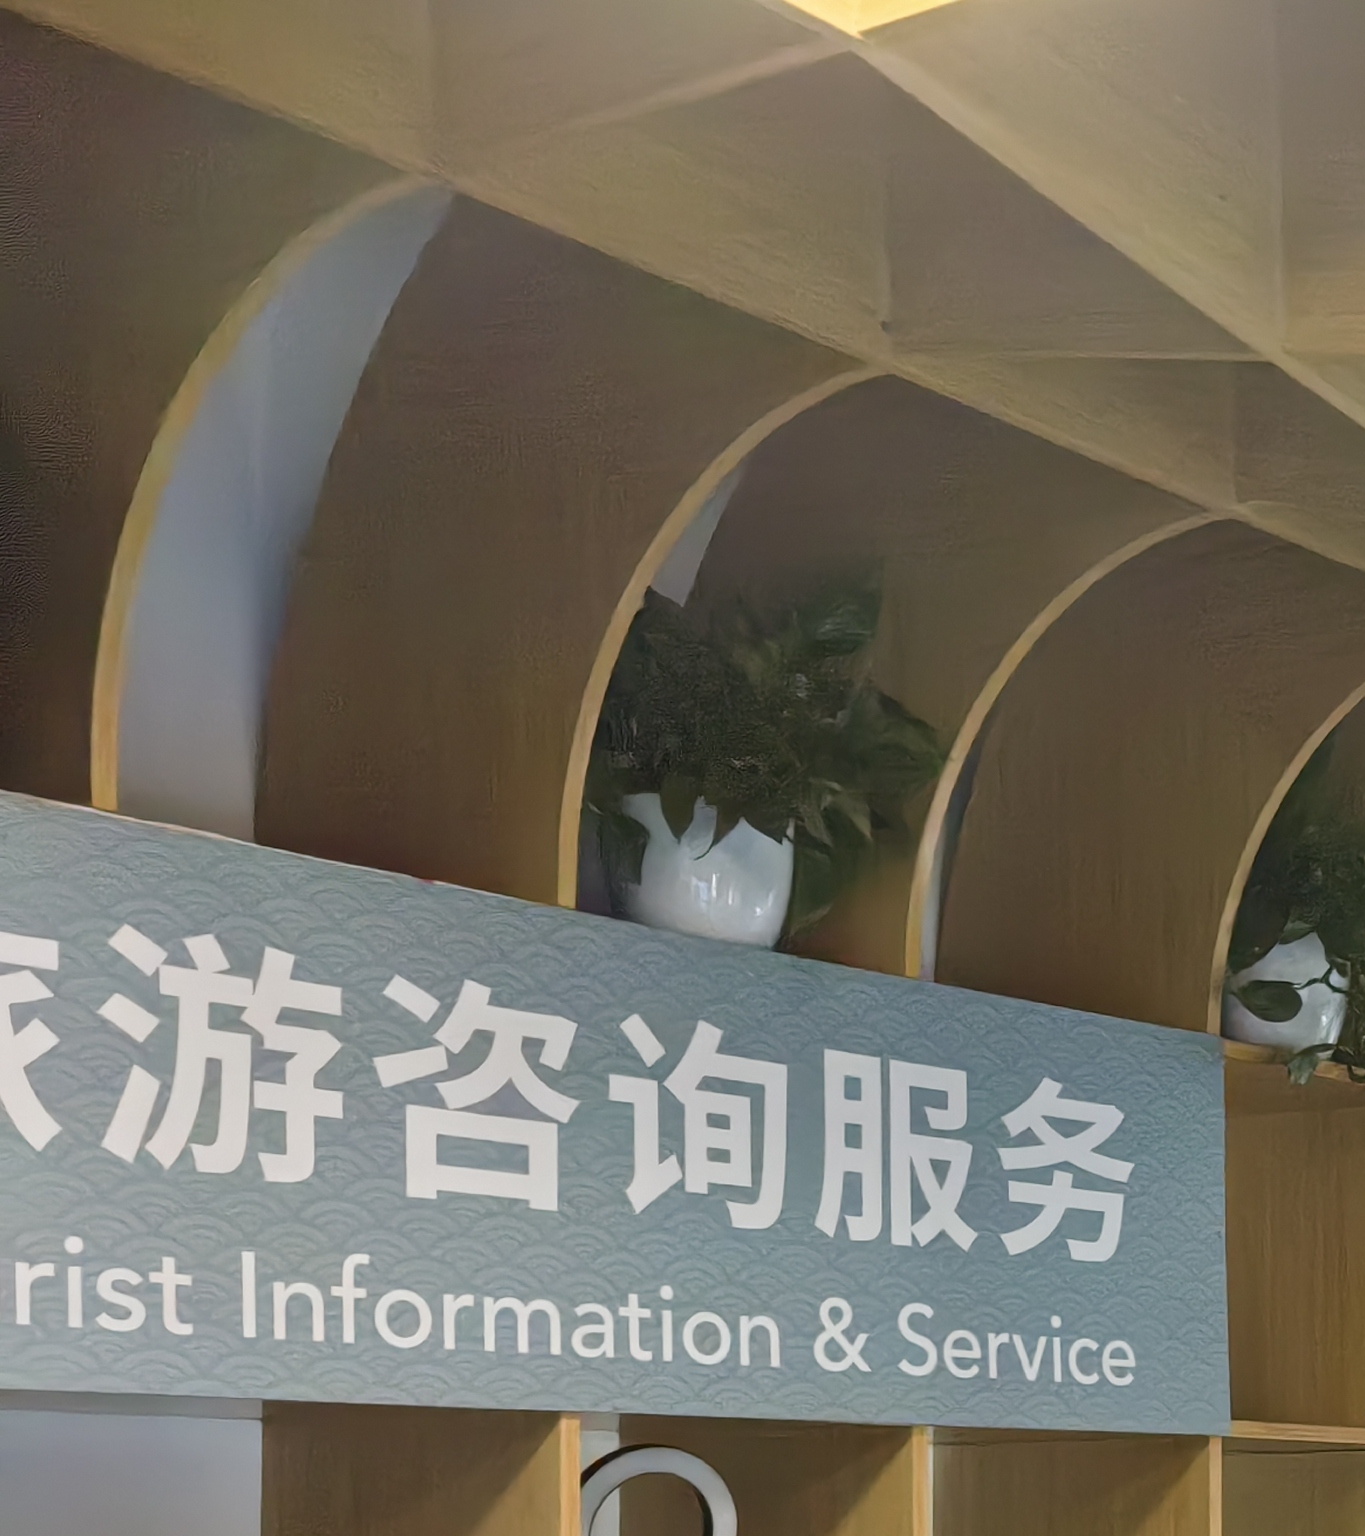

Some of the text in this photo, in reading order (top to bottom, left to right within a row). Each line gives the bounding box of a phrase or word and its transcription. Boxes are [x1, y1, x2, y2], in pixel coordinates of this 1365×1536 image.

[0, 924, 1137, 1263] 游咨询服务
[240, 1250, 783, 1369] Information
[812, 1296, 873, 1373] &
[897, 1302, 1137, 1387] Service
